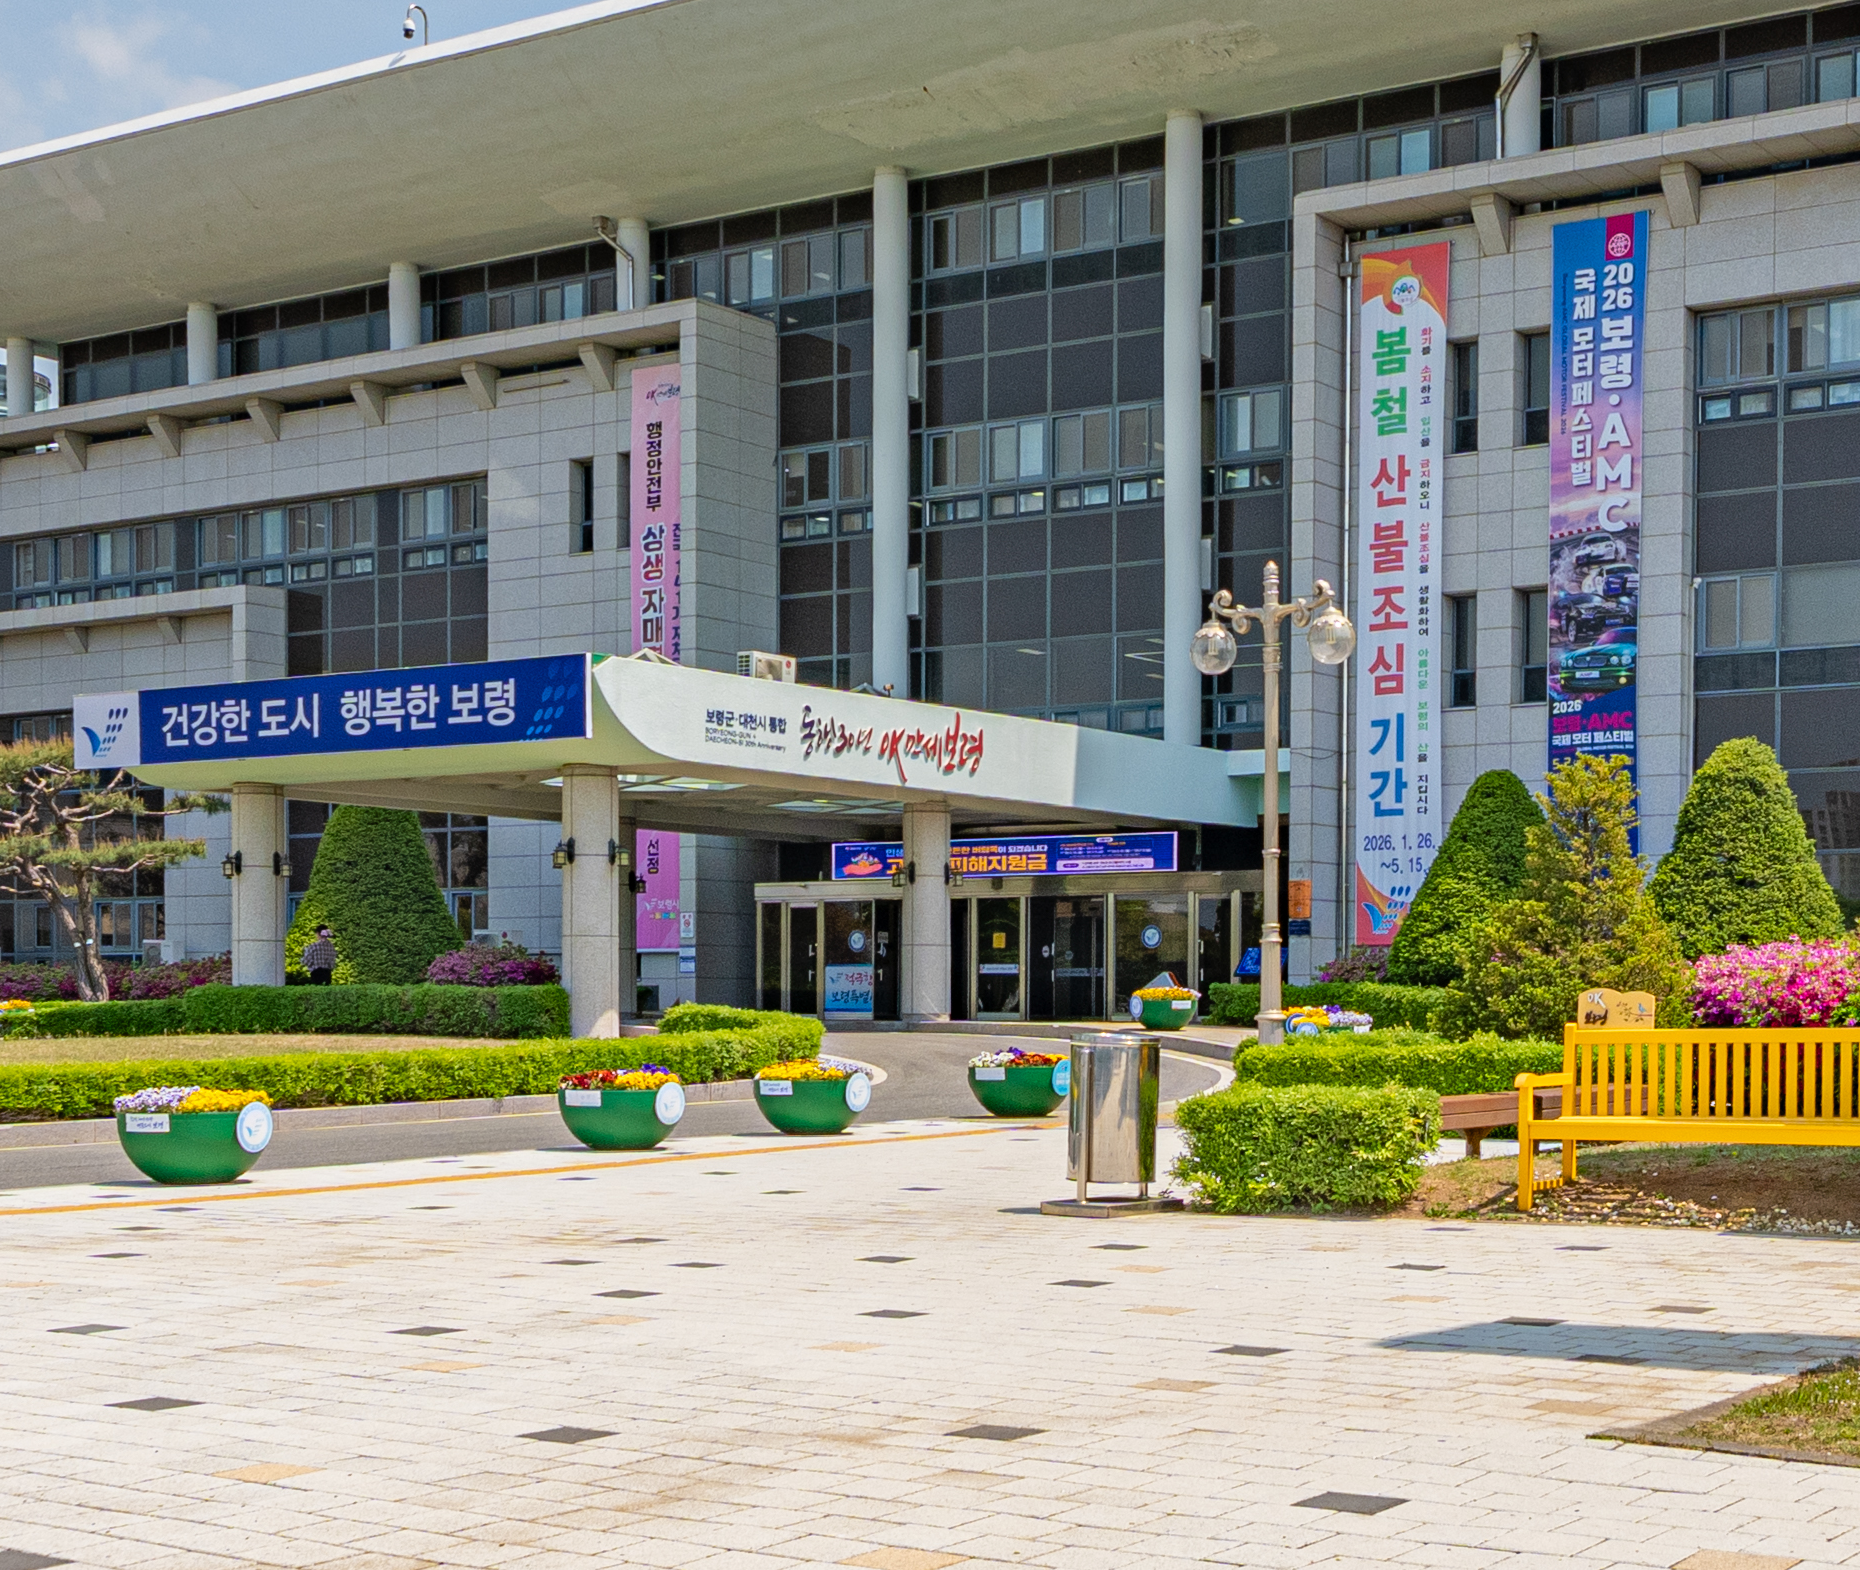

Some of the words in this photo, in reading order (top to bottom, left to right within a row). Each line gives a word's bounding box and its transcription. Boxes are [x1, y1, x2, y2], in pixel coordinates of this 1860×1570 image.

[1573, 268, 1596, 321] 국제
[1371, 326, 1411, 437] 봄철
[1420, 365, 1431, 405] 소지하고
[646, 421, 662, 512] 행정안전부
[1419, 459, 1430, 510] 금지하오니
[642, 524, 665, 581] 상생
[1419, 522, 1430, 574] 산불조심을
[1368, 455, 1411, 696] 산불조심
[1418, 585, 1429, 636] 생활화하여
[1418, 648, 1429, 689] 아름다운
[161, 700, 250, 747] 건강한
[260, 693, 320, 738] 도시
[340, 683, 440, 734] 행복한
[447, 678, 517, 726] 보령
[769, 716, 787, 734] 통합
[1417, 701, 1428, 731] 보령의
[1552, 699, 1582, 715] 2026
[1417, 743, 1428, 763] 산을
[1552, 734, 1571, 746] 국제
[1572, 732, 1592, 745] 모터
[1593, 730, 1634, 743] 페스티벌
[1368, 713, 1408, 817] 기간
[647, 839, 659, 874] 선정
[950, 854, 1048, 872] 피해지원금
[1364, 835, 1396, 851] 2026.
[657, 899, 679, 910] 보령시
[832, 989, 873, 1005] 보령특별
[1587, 992, 1606, 1008] OK
